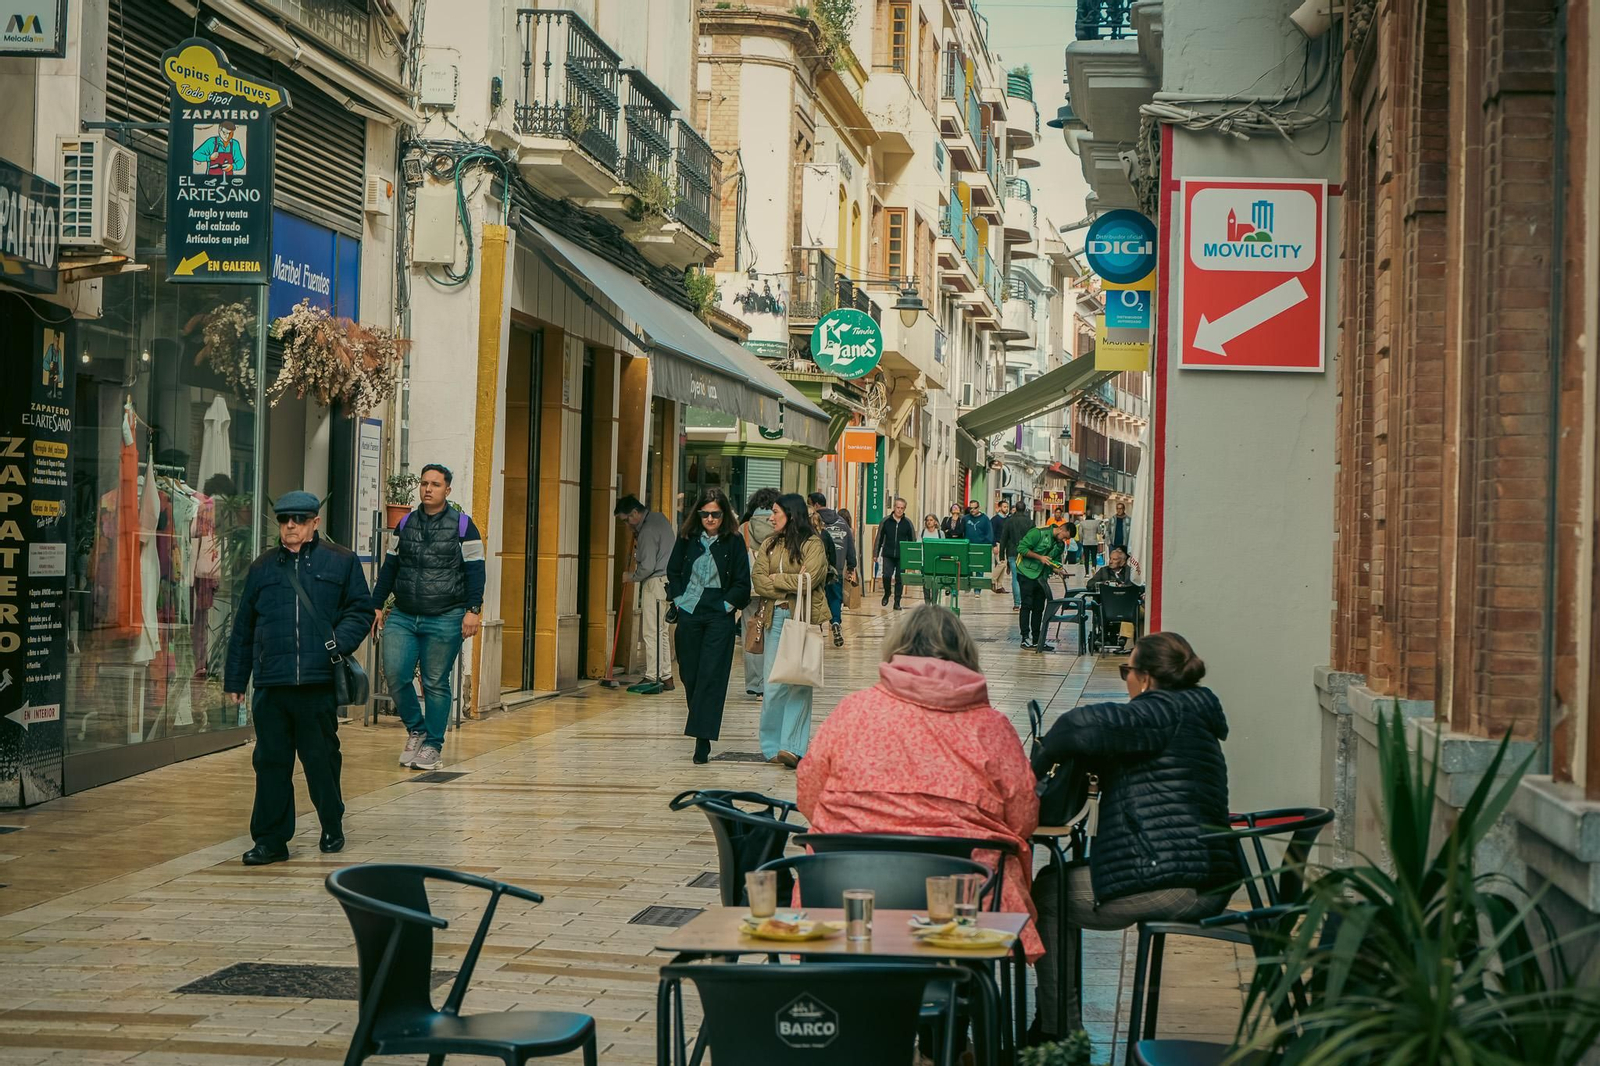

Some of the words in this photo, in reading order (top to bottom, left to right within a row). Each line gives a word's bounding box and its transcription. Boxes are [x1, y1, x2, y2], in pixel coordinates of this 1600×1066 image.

[170, 60, 209, 82] Copias
[215, 74, 229, 88] de
[235, 80, 271, 101] llaves
[180, 84, 204, 99] Todo
[207, 92, 233, 105] tipo!
[182, 109, 259, 120] ZAPATERO
[179, 175, 195, 186] EL
[176, 186, 260, 204] ARTESANO
[188, 208, 218, 220] Arreglo
[219, 211, 225, 220] y
[226, 210, 248, 218] venta
[195, 221, 208, 231] del
[210, 221, 240, 231] calzado
[186, 234, 220, 244] Artículos
[222, 236, 232, 244] en
[234, 234, 249, 246] piel
[1088, 241, 1153, 255] DIGI
[1203, 243, 1302, 259] MOVILCITY
[207, 261, 220, 271] EN
[222, 261, 261, 272] GALERIA
[272, 254, 301, 287] Maribel
[302, 264, 330, 295] Fuentes
[31, 402, 70, 416] ZAPATERO
[22, 413, 35, 425] EL
[35, 414, 72, 433] ARTESANO
[24, 710, 30, 720] EN
[33, 707, 56, 719] INTERIOR
[780, 1021, 835, 1036] BARCO
